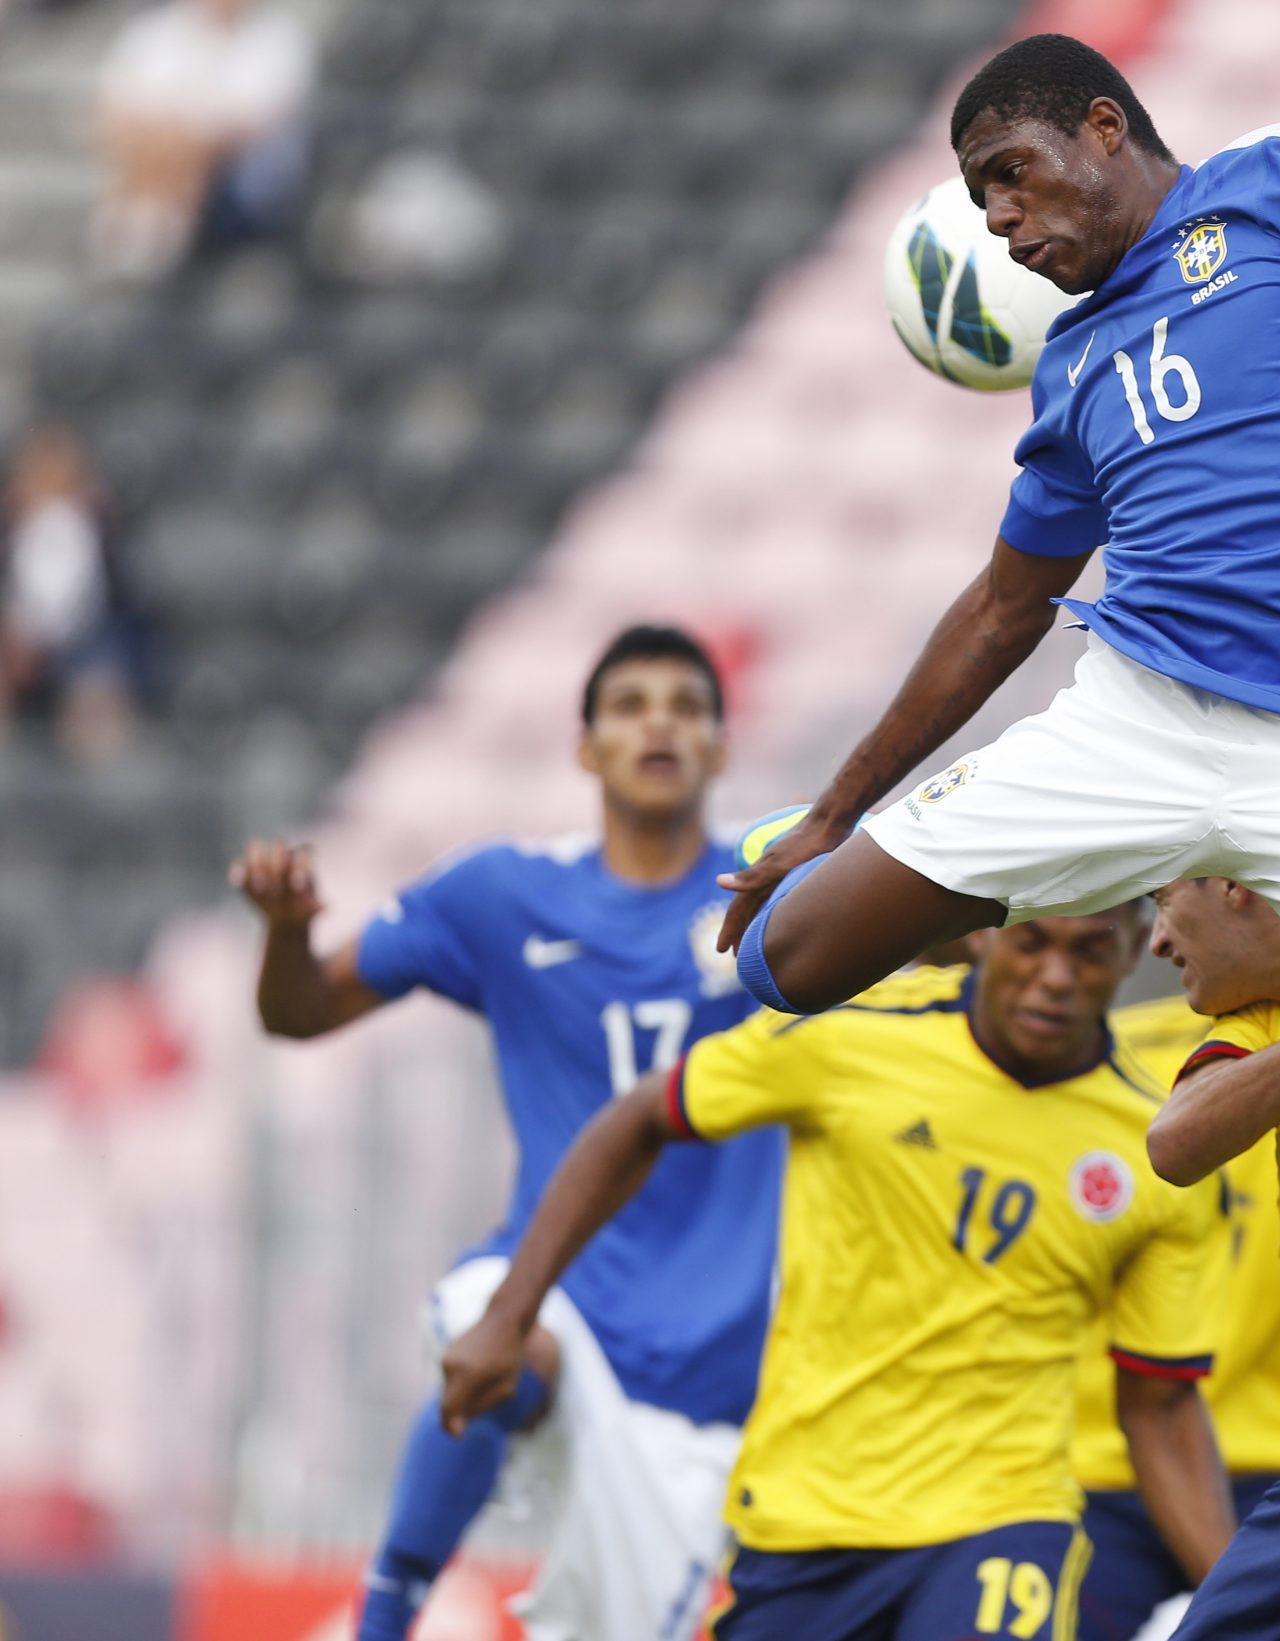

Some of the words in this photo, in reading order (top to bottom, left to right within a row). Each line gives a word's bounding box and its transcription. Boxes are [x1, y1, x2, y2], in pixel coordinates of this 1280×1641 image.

[1191, 270, 1239, 305] BRASIL
[1113, 316, 1201, 445] 16
[603, 999, 692, 1097] 17
[953, 1166, 1037, 1265] 19
[975, 1556, 1053, 1640] 19
